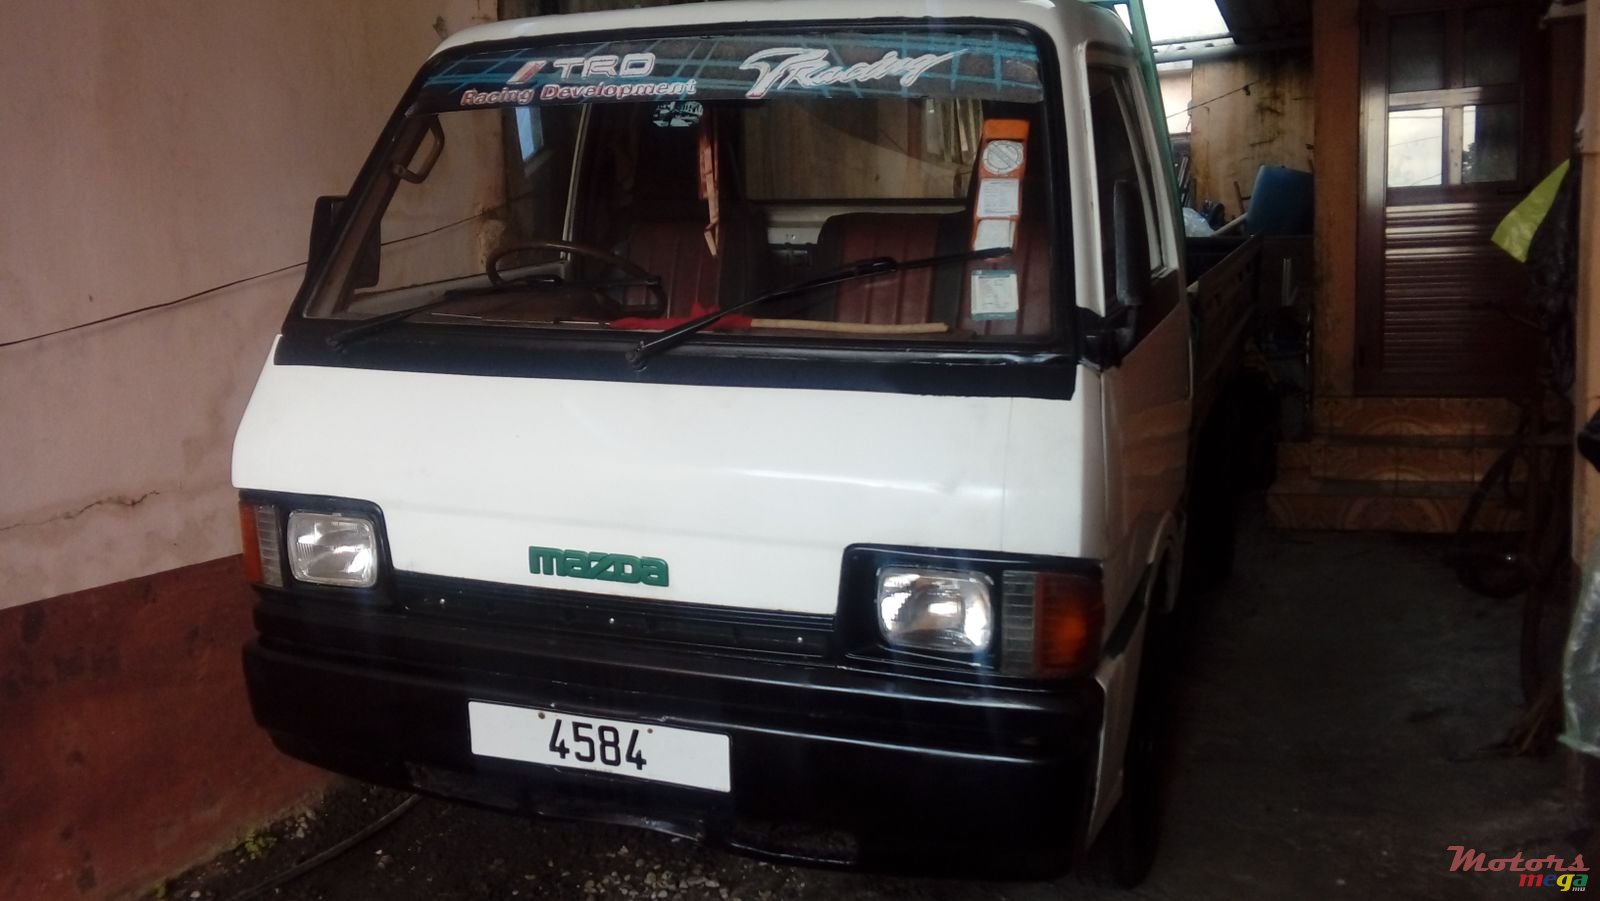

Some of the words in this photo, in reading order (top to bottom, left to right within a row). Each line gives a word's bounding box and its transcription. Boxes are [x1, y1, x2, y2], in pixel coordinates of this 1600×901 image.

[553, 52, 656, 79] TRD
[460, 86, 535, 106] Racing
[540, 78, 697, 101] Development
[548, 718, 647, 770] 4584
